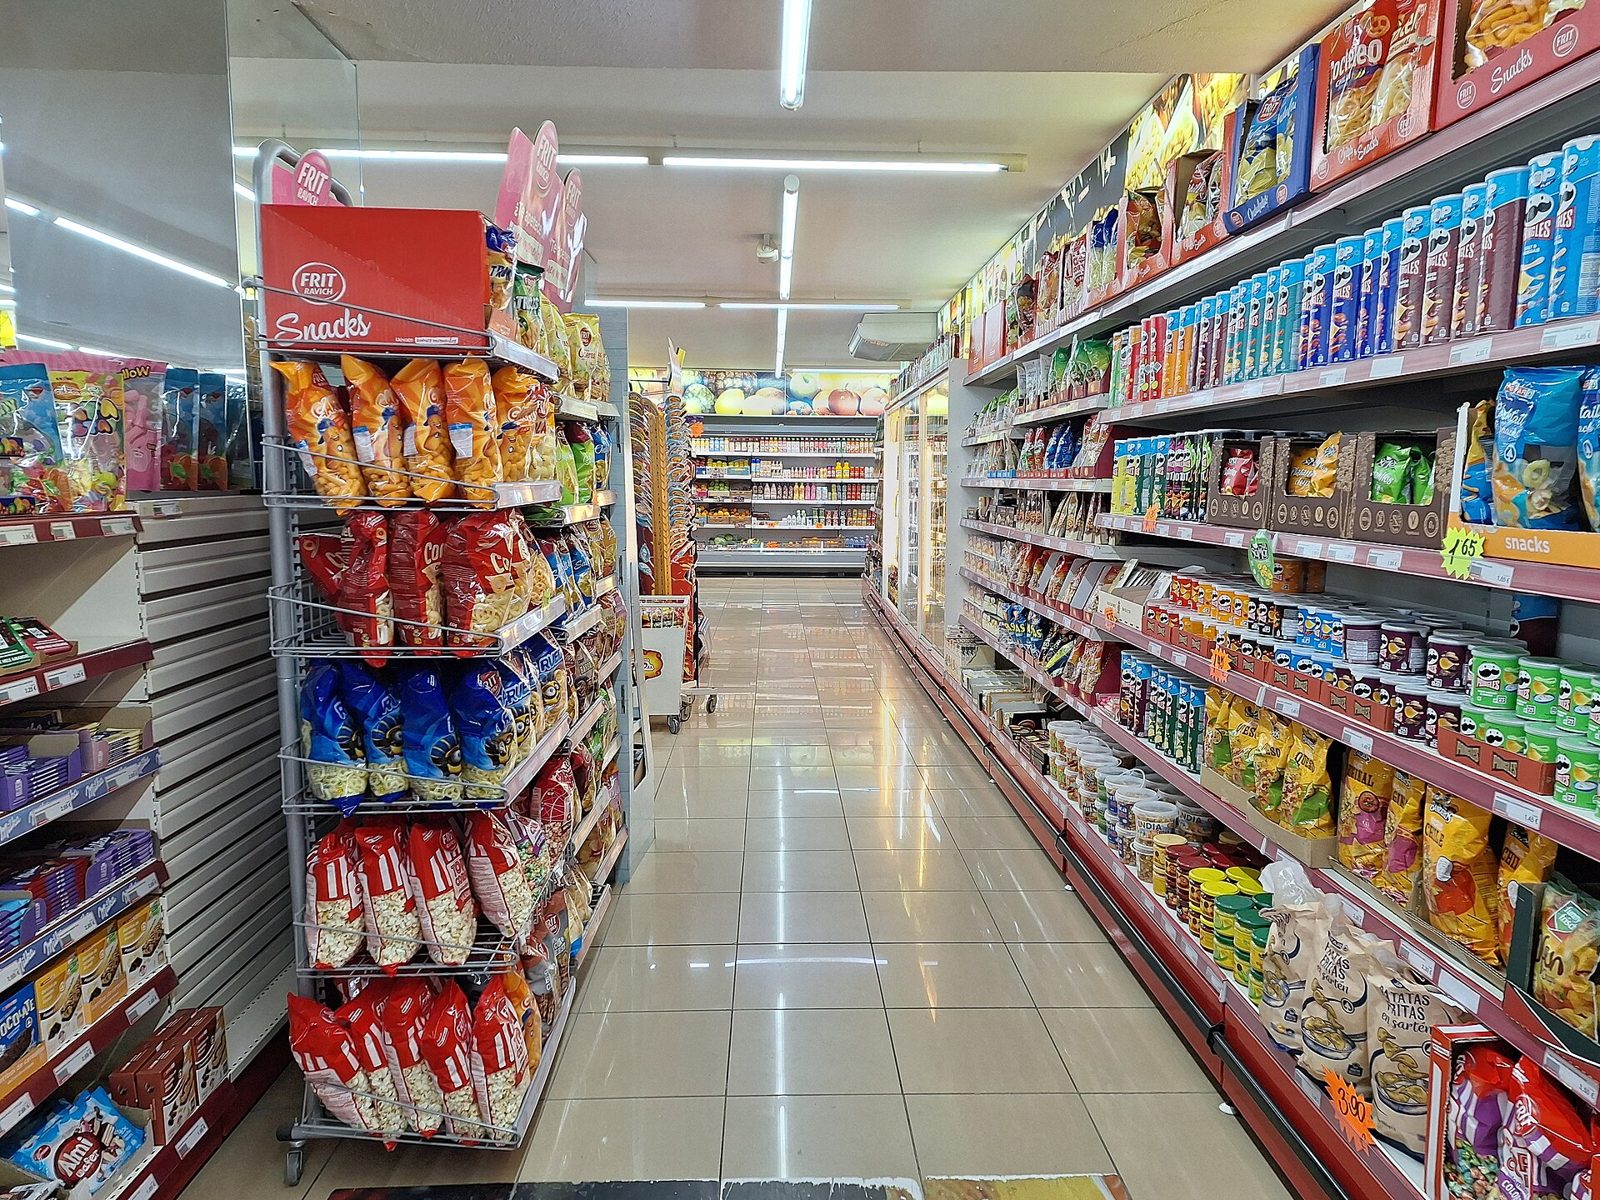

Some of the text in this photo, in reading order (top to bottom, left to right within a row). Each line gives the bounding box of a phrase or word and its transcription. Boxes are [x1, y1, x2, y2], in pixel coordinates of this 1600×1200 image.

[1556, 28, 1575, 48] FRIT
[1490, 48, 1534, 95] Snacks
[1262, 101, 1280, 114] FRIT
[537, 134, 557, 170] FRIT
[297, 161, 329, 195] FRIT
[1525, 218, 1552, 240] GLES
[1402, 259, 1420, 275] GLES
[1429, 252, 1448, 268] GLES
[300, 272, 337, 287] FRIT
[304, 287, 333, 296] RAVICH
[274, 307, 371, 347] Snacks
[1505, 535, 1550, 553] snacks
[1425, 822, 1445, 848] CHILE
[1501, 847, 1520, 871] CHIL
[545, 916, 557, 928] RIT
[1321, 971, 1349, 994] sartén
[1387, 1003, 1426, 1020] FRITAS
[1381, 1013, 1432, 1035] en sartén
[57, 1136, 94, 1178] Almi
[1501, 1179, 1522, 1200] COLO
